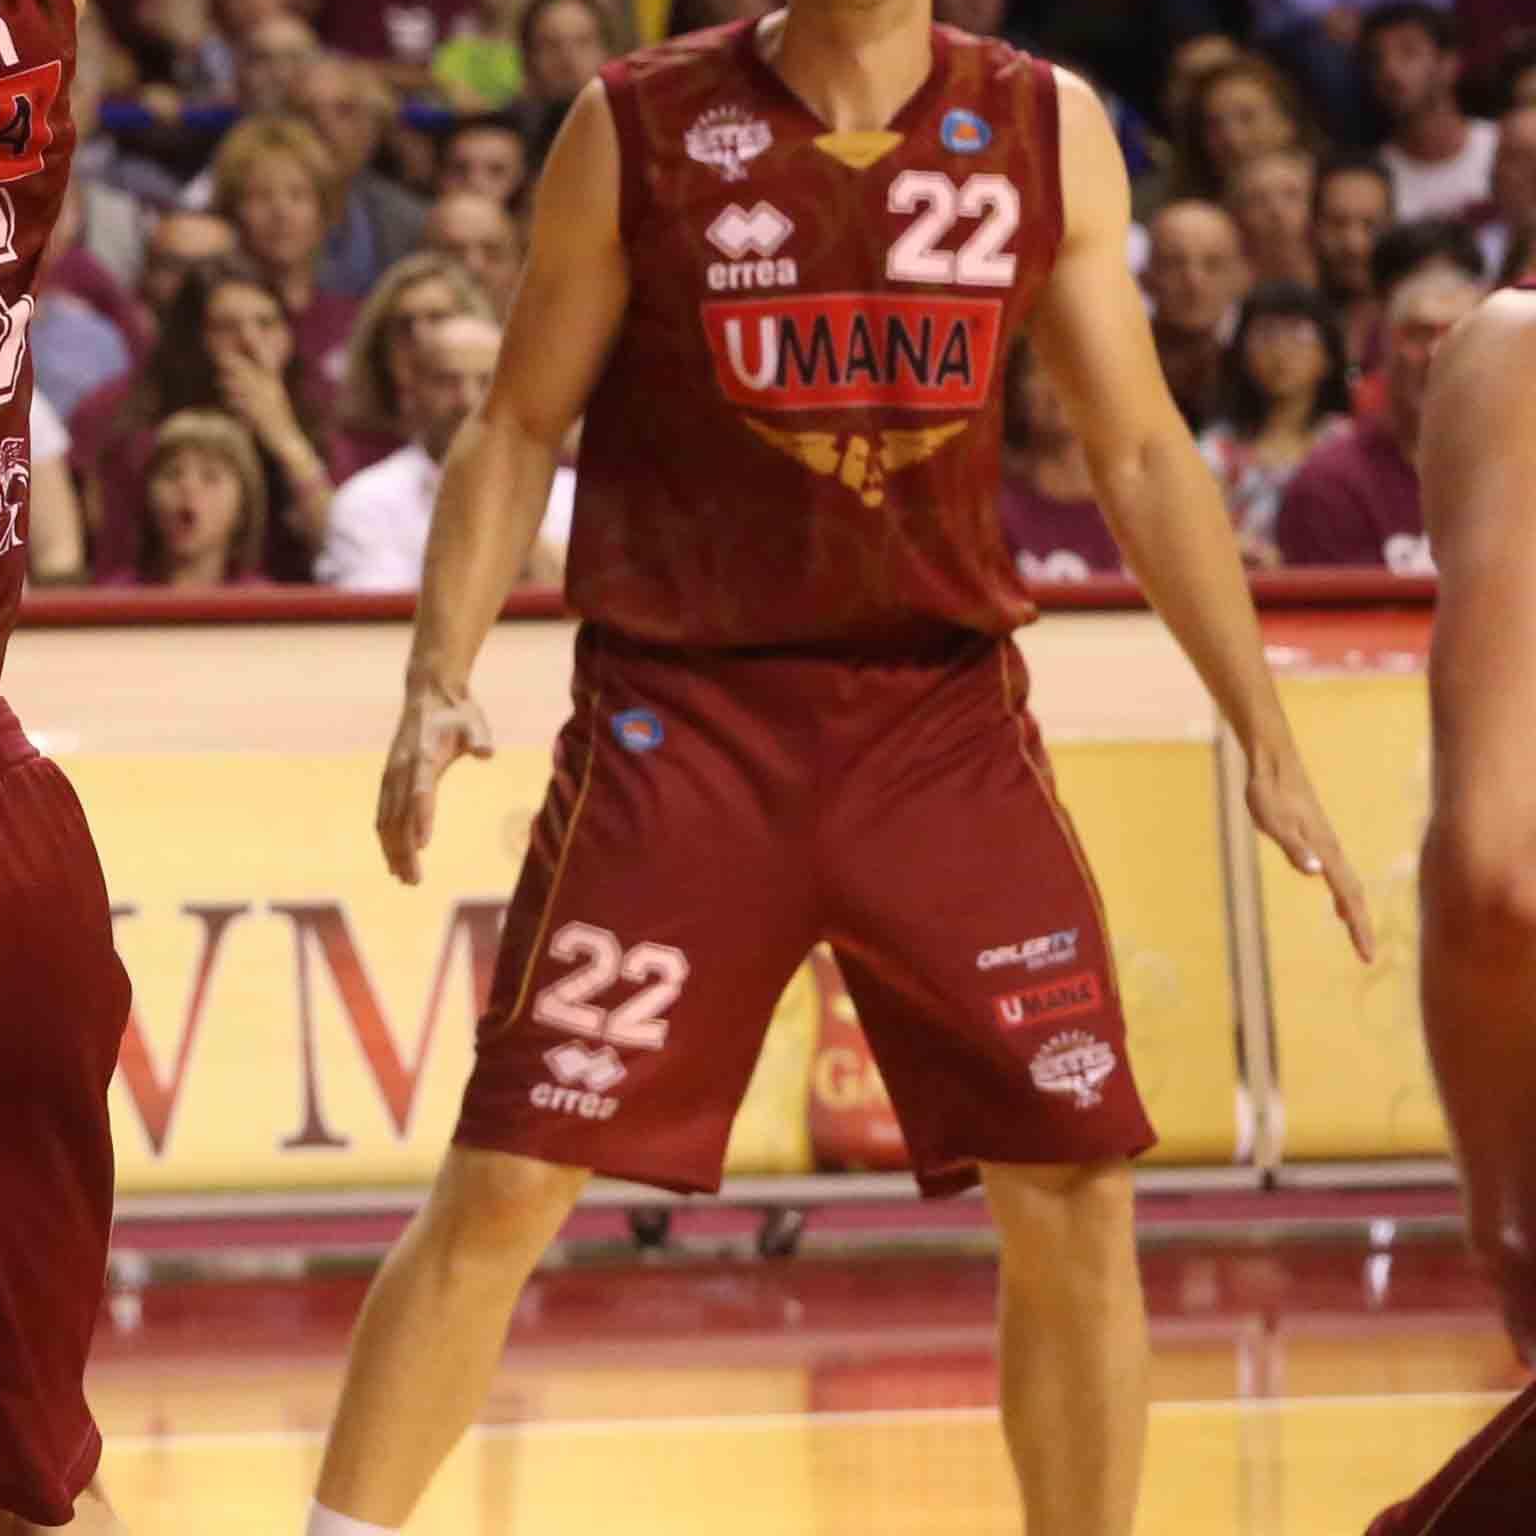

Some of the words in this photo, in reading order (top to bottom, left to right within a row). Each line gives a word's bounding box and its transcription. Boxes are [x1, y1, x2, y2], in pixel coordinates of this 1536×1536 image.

[886, 170, 1021, 287] 22
[724, 314, 973, 390] UMANA
[532, 920, 691, 1051] 22
